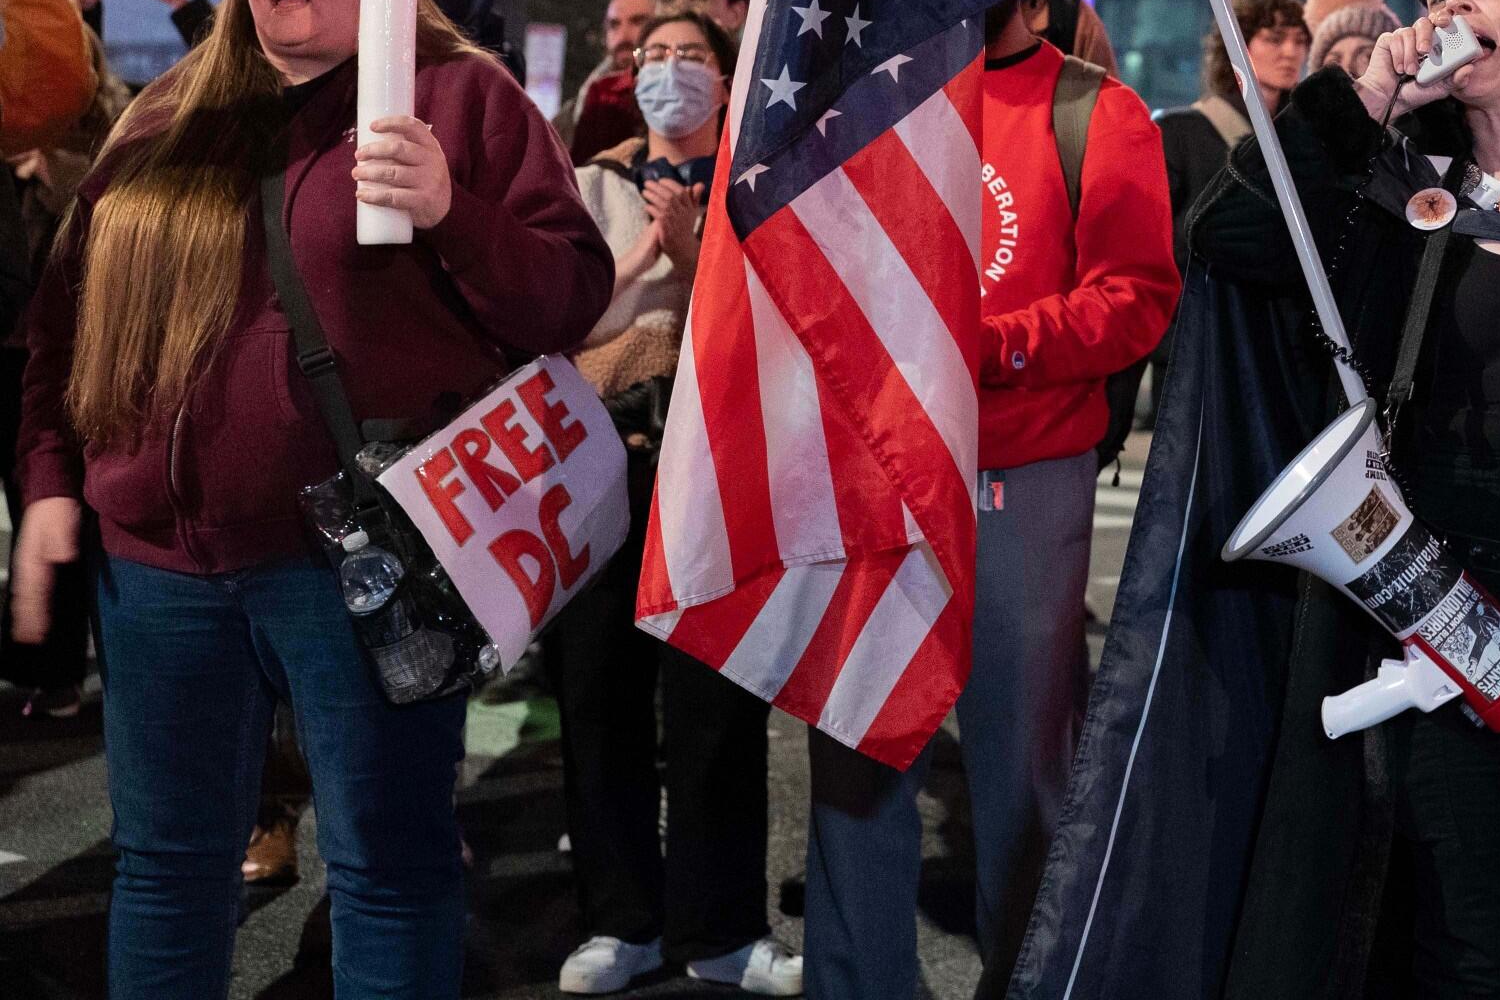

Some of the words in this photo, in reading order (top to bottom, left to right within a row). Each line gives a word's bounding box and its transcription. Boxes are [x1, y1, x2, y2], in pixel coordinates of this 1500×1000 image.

[981, 162, 1019, 282] BERATION
[413, 369, 588, 547] FREE
[488, 483, 590, 631] DC
[1420, 579, 1474, 641] BILLIONAIRES
